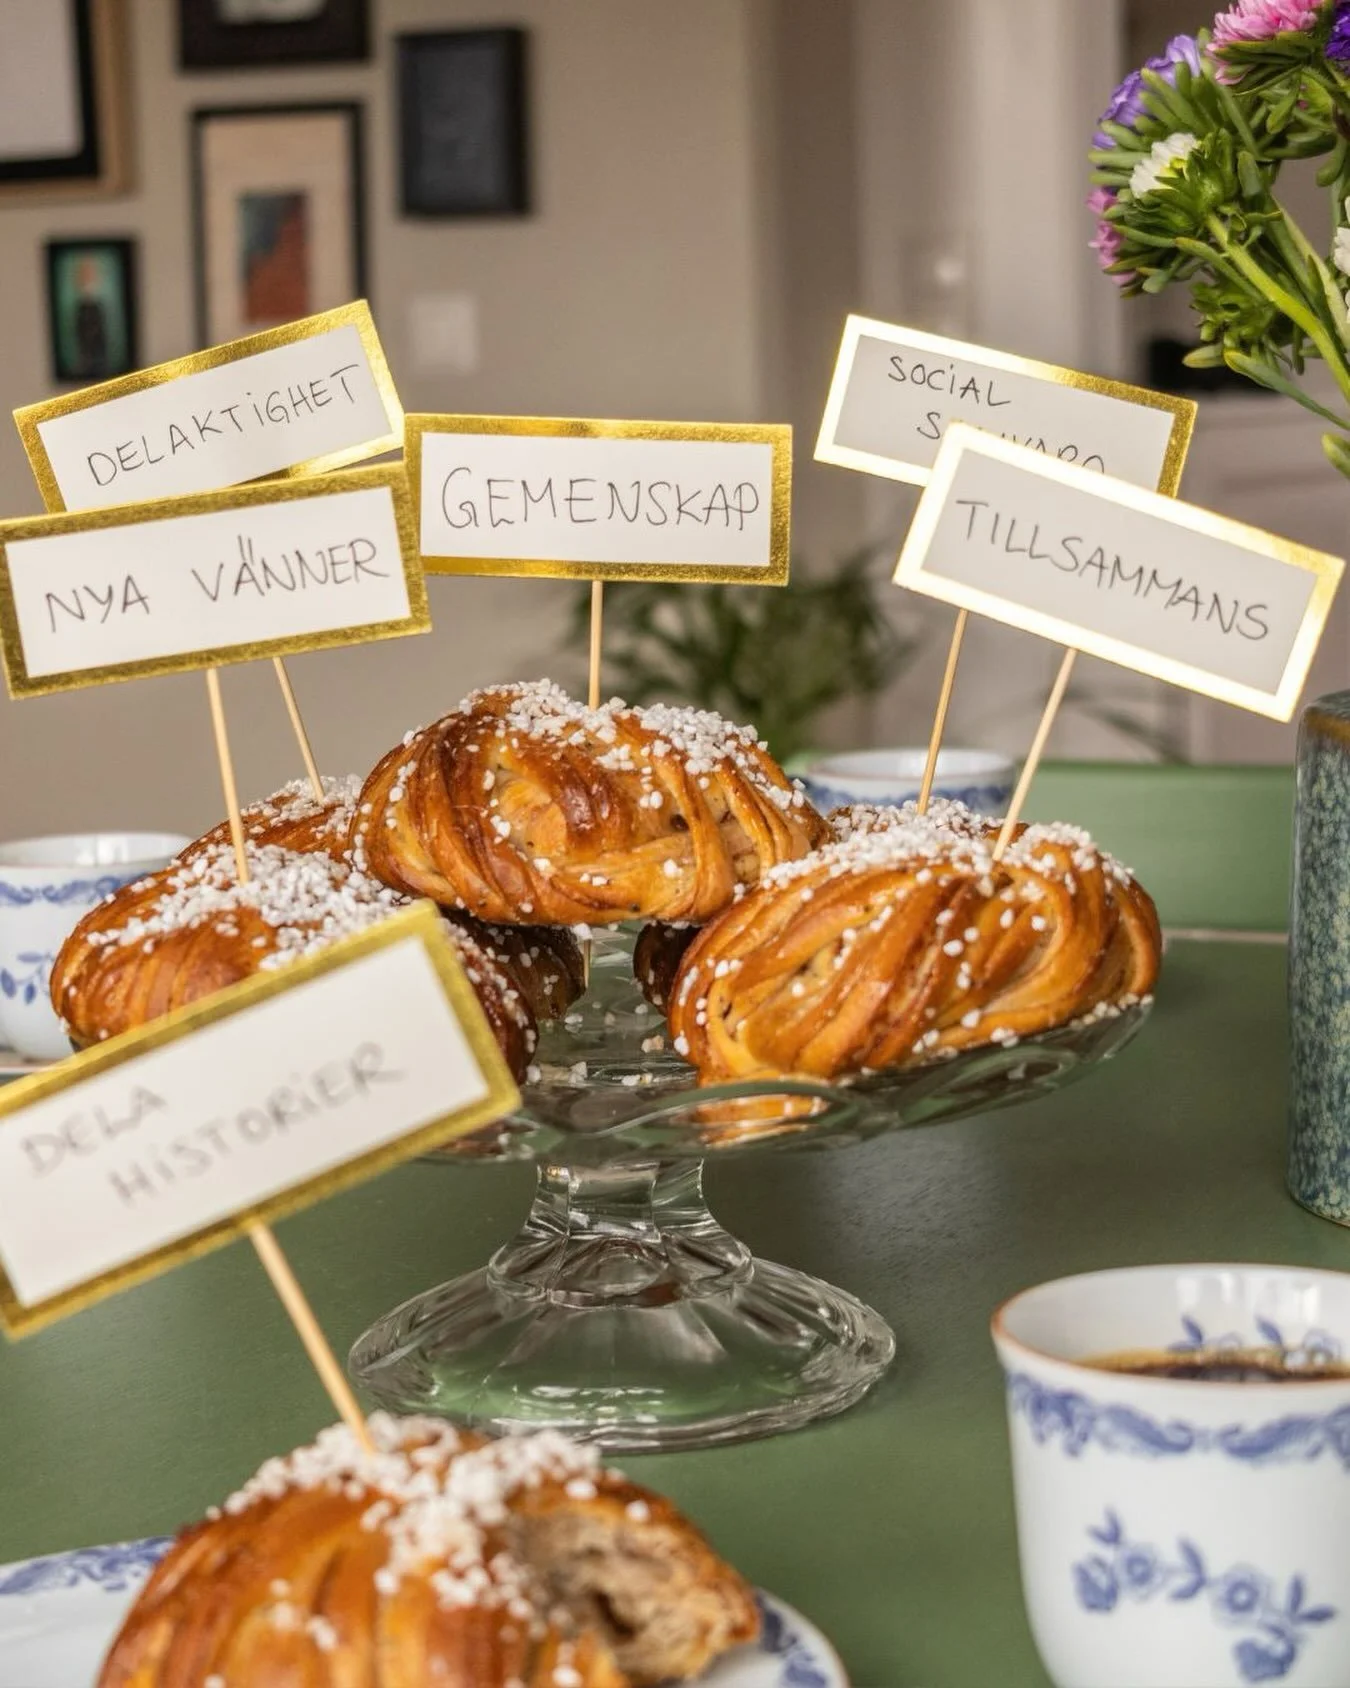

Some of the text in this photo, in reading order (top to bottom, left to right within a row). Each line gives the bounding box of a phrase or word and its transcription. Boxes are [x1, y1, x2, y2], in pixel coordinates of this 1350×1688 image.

[441, 466, 760, 532] GEMENSKAP
[45, 534, 391, 633] NYA VÄNNER
[955, 499, 1270, 641] TILLSAMMANS
[19, 1084, 168, 1177] DELA
